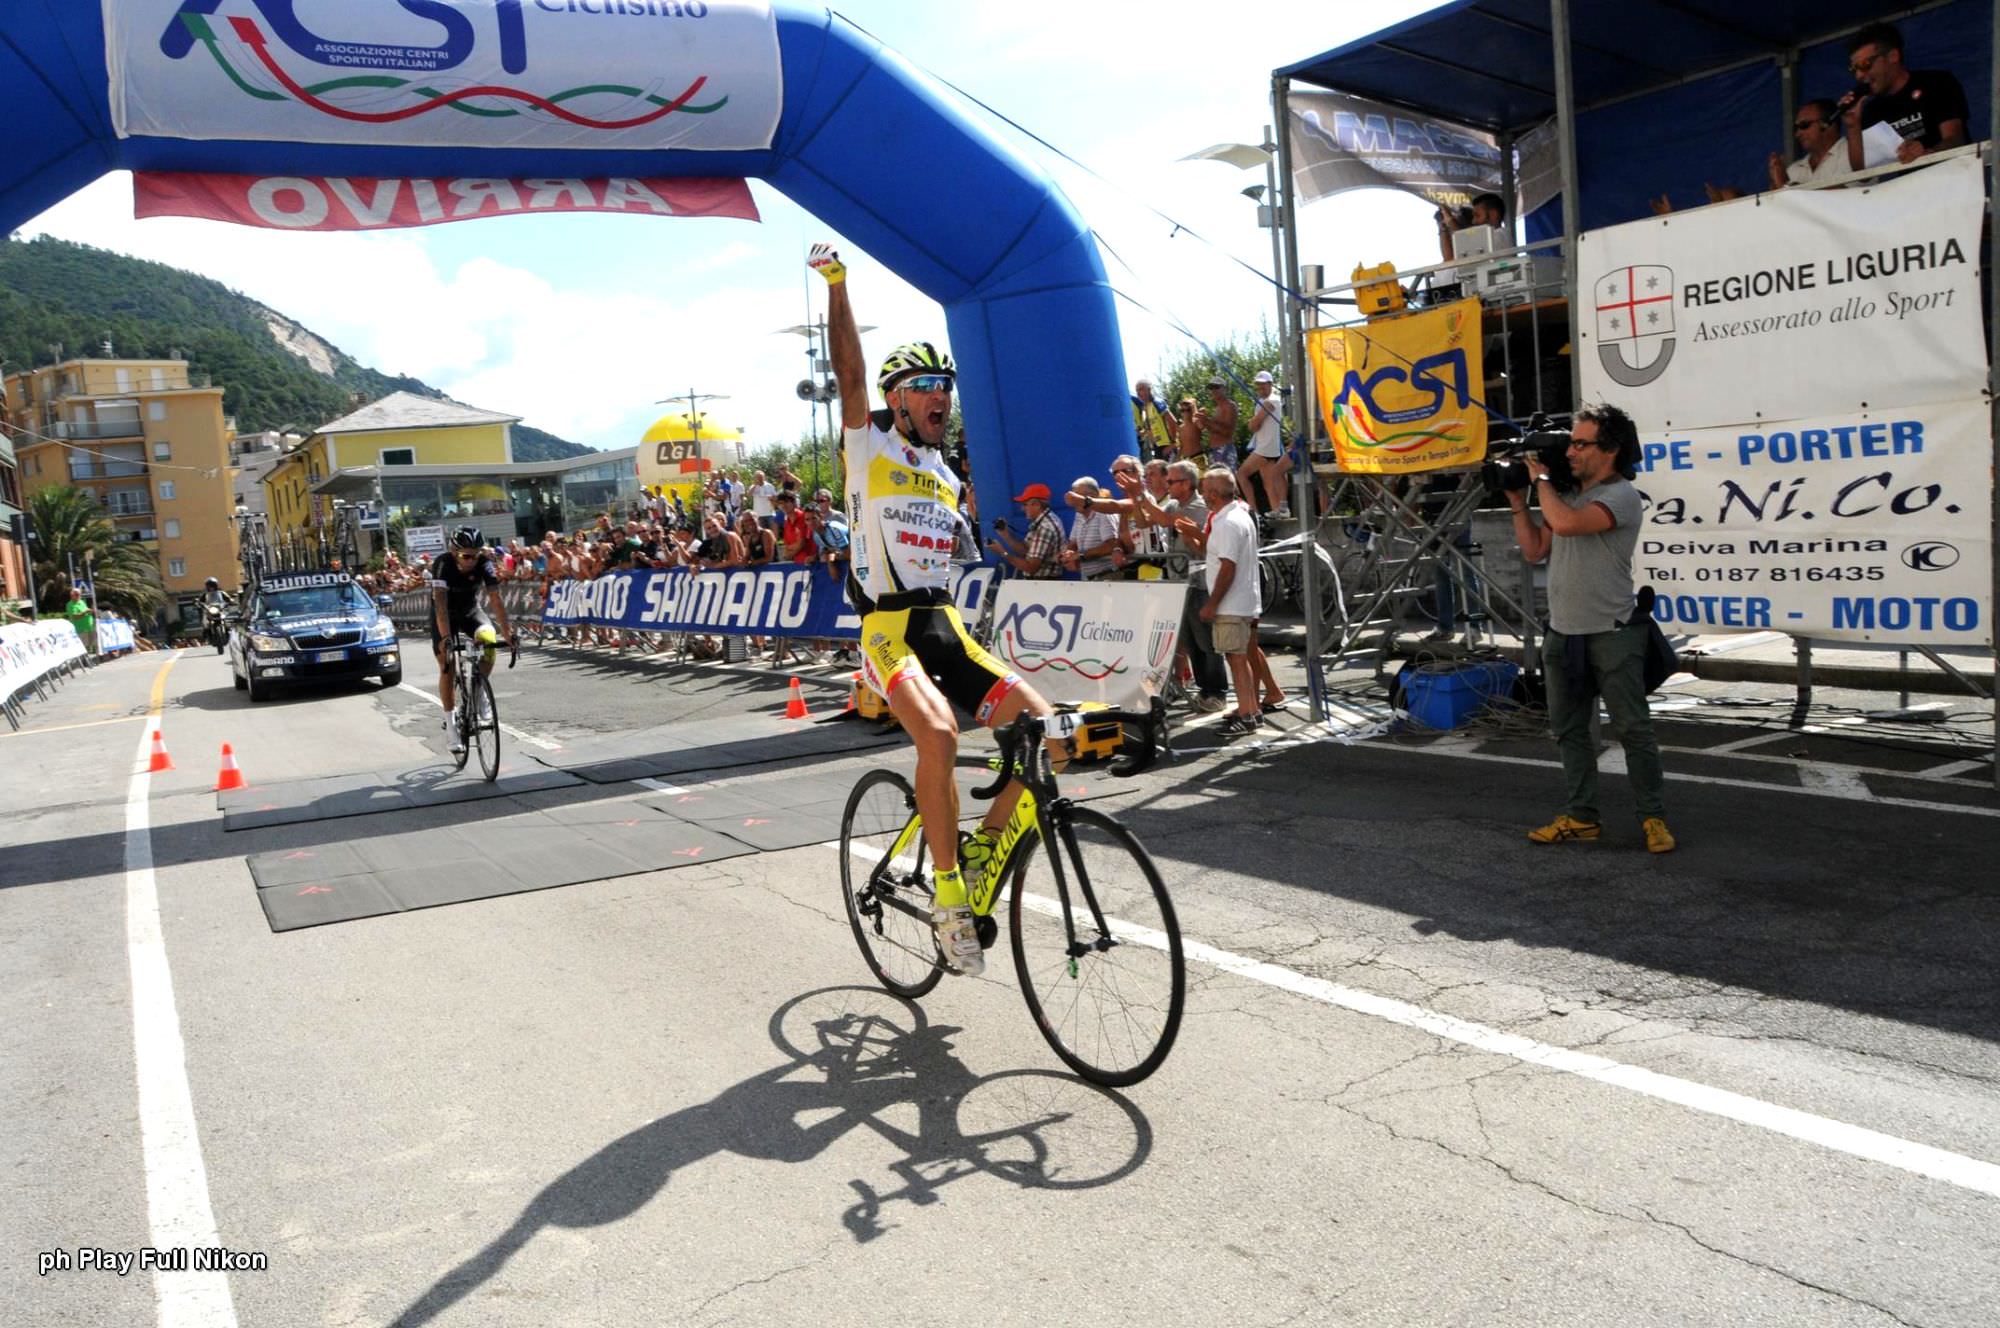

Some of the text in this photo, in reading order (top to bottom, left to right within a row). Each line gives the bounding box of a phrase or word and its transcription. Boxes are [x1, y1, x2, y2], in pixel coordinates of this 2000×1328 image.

[315, 44, 449, 60] ASSOCIAZIONE CENTRI
[329, 54, 437, 69] SPORTIVI ITALIANI
[1890, 112, 1922, 129] TELLI
[1684, 238, 1967, 308] REGIONE LIGURIA
[1693, 288, 1955, 343] Assessorato allo Sport
[1332, 348, 1471, 424] ACSI
[659, 445, 696, 461] LGL
[1738, 420, 1924, 466] PORTER
[883, 507, 952, 532] SAINT-GO
[1642, 538, 1888, 555] Deiva Marina
[261, 573, 350, 590] SHIMANO
[1644, 566, 1885, 582] Tel. 0187 816435
[640, 570, 812, 628] SHIMANO
[1651, 593, 1771, 628] OOTER
[1832, 597, 1979, 631] MOTO
[993, 602, 1083, 652] ACSI
[1081, 621, 1134, 644] Ciclismo
[1152, 619, 1177, 631] Italia
[973, 810, 1021, 907] CIPOLLINI
